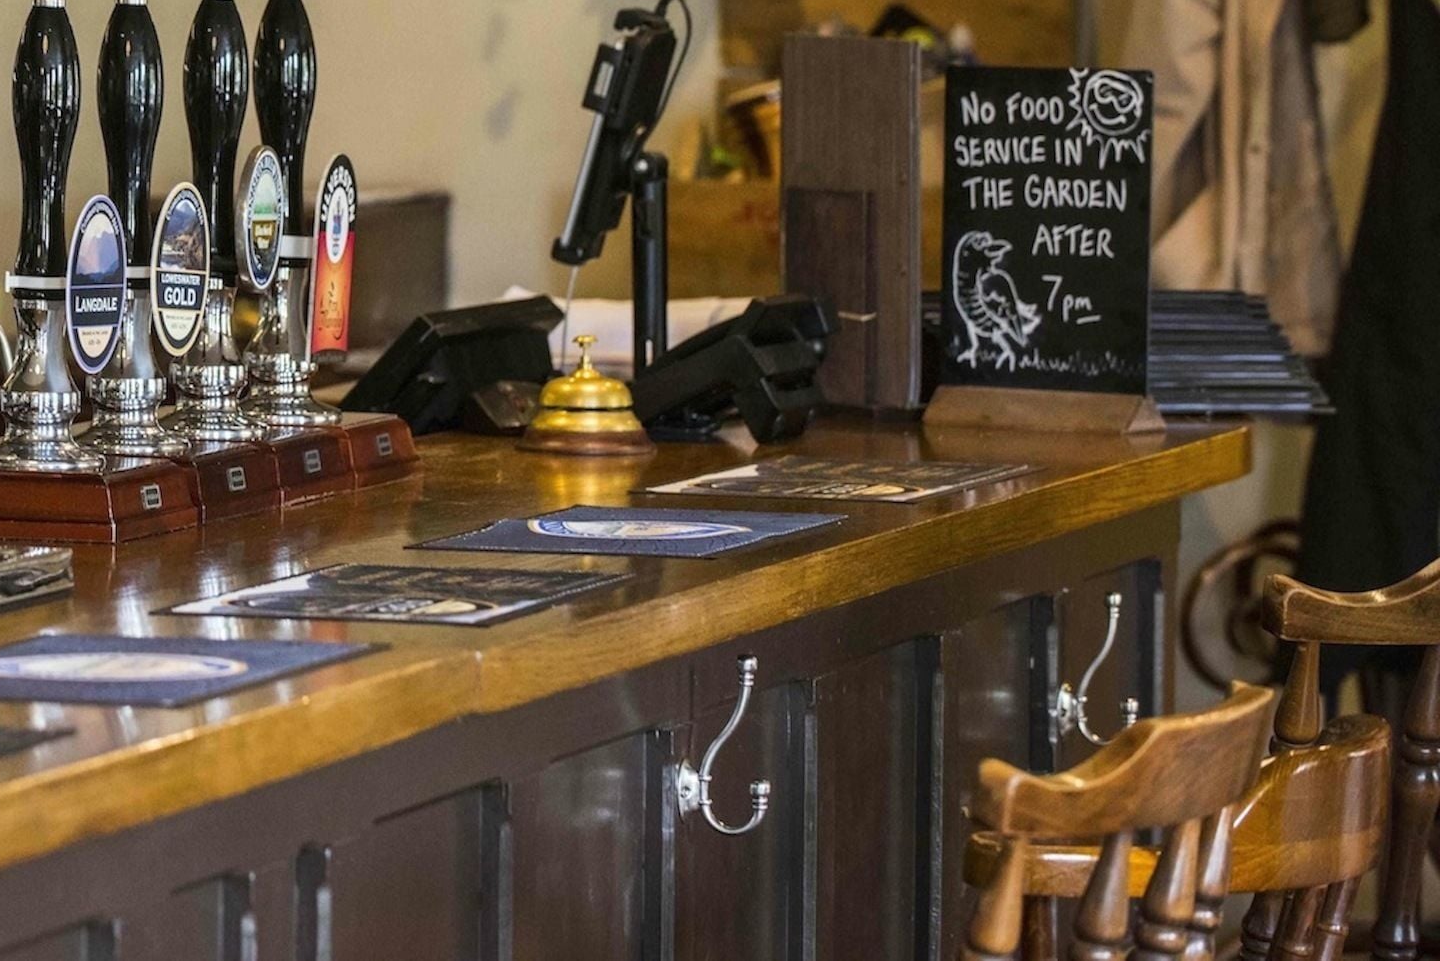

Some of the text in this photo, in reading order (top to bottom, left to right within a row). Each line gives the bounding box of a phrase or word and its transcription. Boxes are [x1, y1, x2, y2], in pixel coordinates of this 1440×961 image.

[961, 91, 1064, 126] No FOOD
[954, 135, 1083, 167] SERVICE IN
[962, 174, 1127, 212] THE GARDEN
[1032, 224, 1114, 259] AFTER
[75, 294, 118, 314] LANGDALE
[164, 286, 196, 306] GOLD
